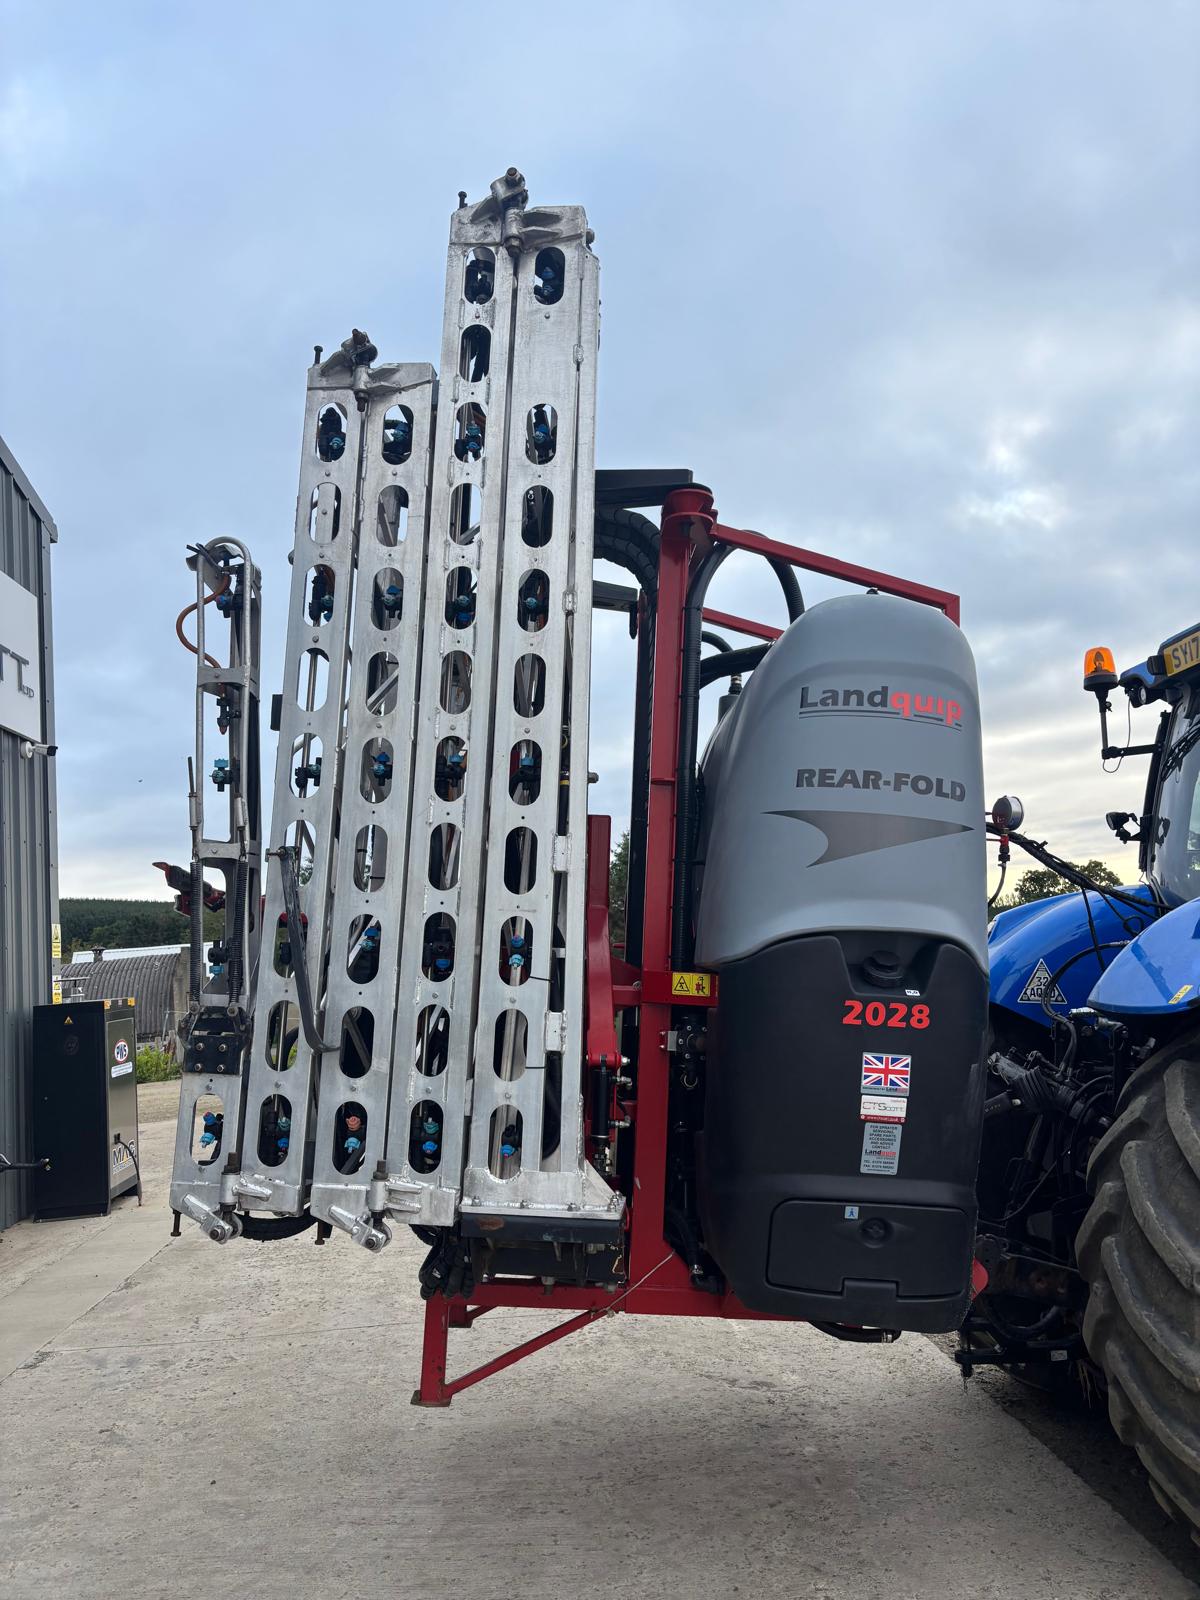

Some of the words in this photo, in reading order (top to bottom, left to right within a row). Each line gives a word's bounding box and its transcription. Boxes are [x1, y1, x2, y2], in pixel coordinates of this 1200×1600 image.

[800, 686, 964, 725] Landquip
[796, 768, 966, 802] REAR-FOLD
[842, 1000, 930, 1029] 2028
